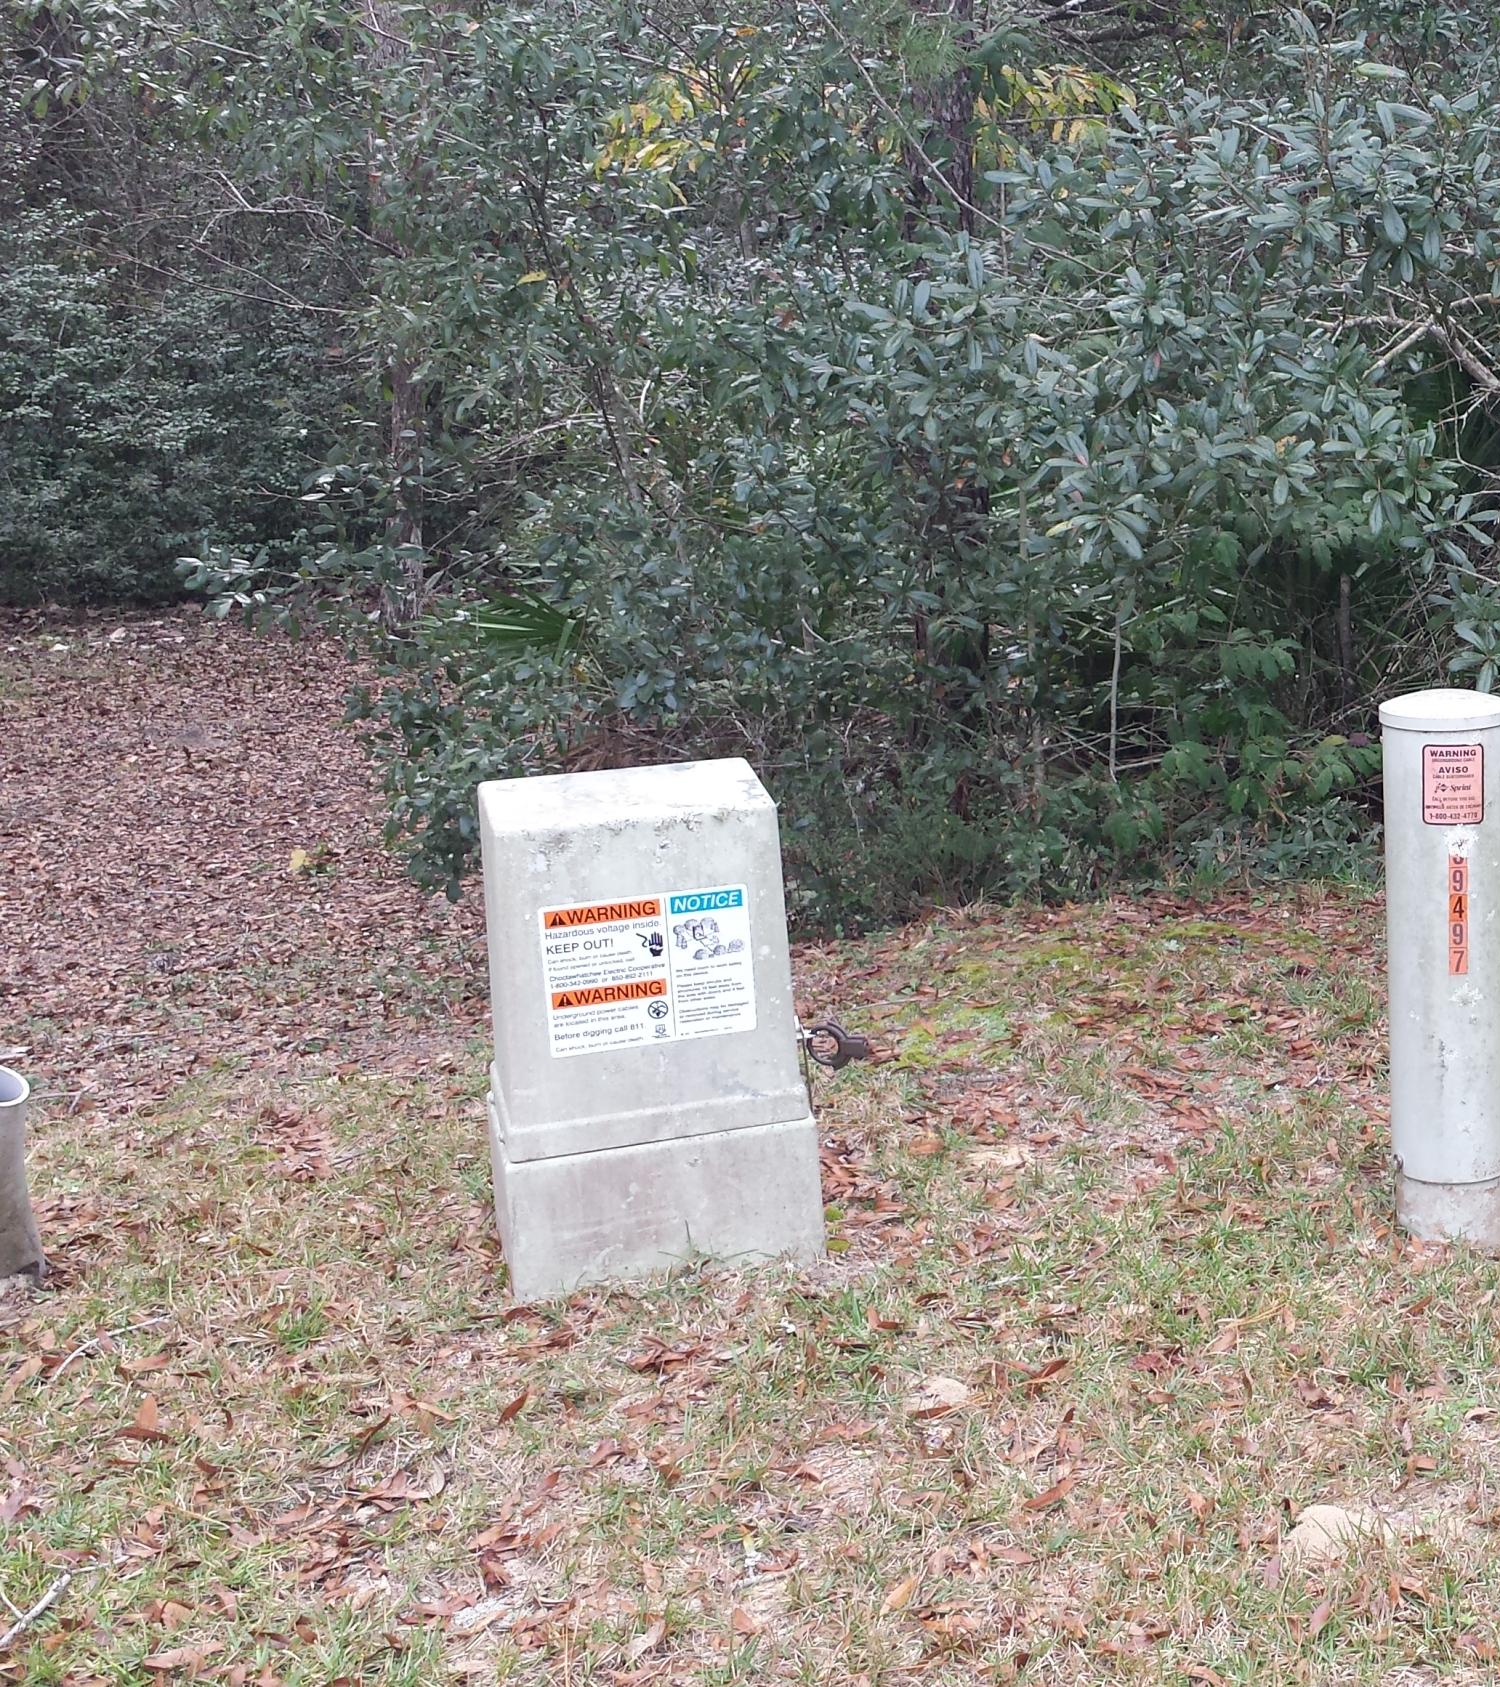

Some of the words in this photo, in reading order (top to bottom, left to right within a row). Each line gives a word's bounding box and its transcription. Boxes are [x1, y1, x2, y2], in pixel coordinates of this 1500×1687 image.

[1439, 766, 1469, 774] AVISO
[1450, 784, 1471, 792] Sprint
[673, 892, 740, 912] NOTICE
[567, 901, 656, 924] WARNING
[545, 928, 594, 940] Hazardous
[597, 923, 630, 934] voltage
[546, 942, 579, 955] KEEP
[584, 938, 614, 950] OUT!
[604, 967, 626, 975] Electric
[628, 963, 665, 972] Cooperative
[574, 981, 662, 1004] WARNING
[553, 1010, 596, 1021] Underground
[597, 1008, 616, 1016] power
[555, 1031, 580, 1041] Before
[583, 1027, 612, 1038] digging
[615, 1025, 628, 1033] call
